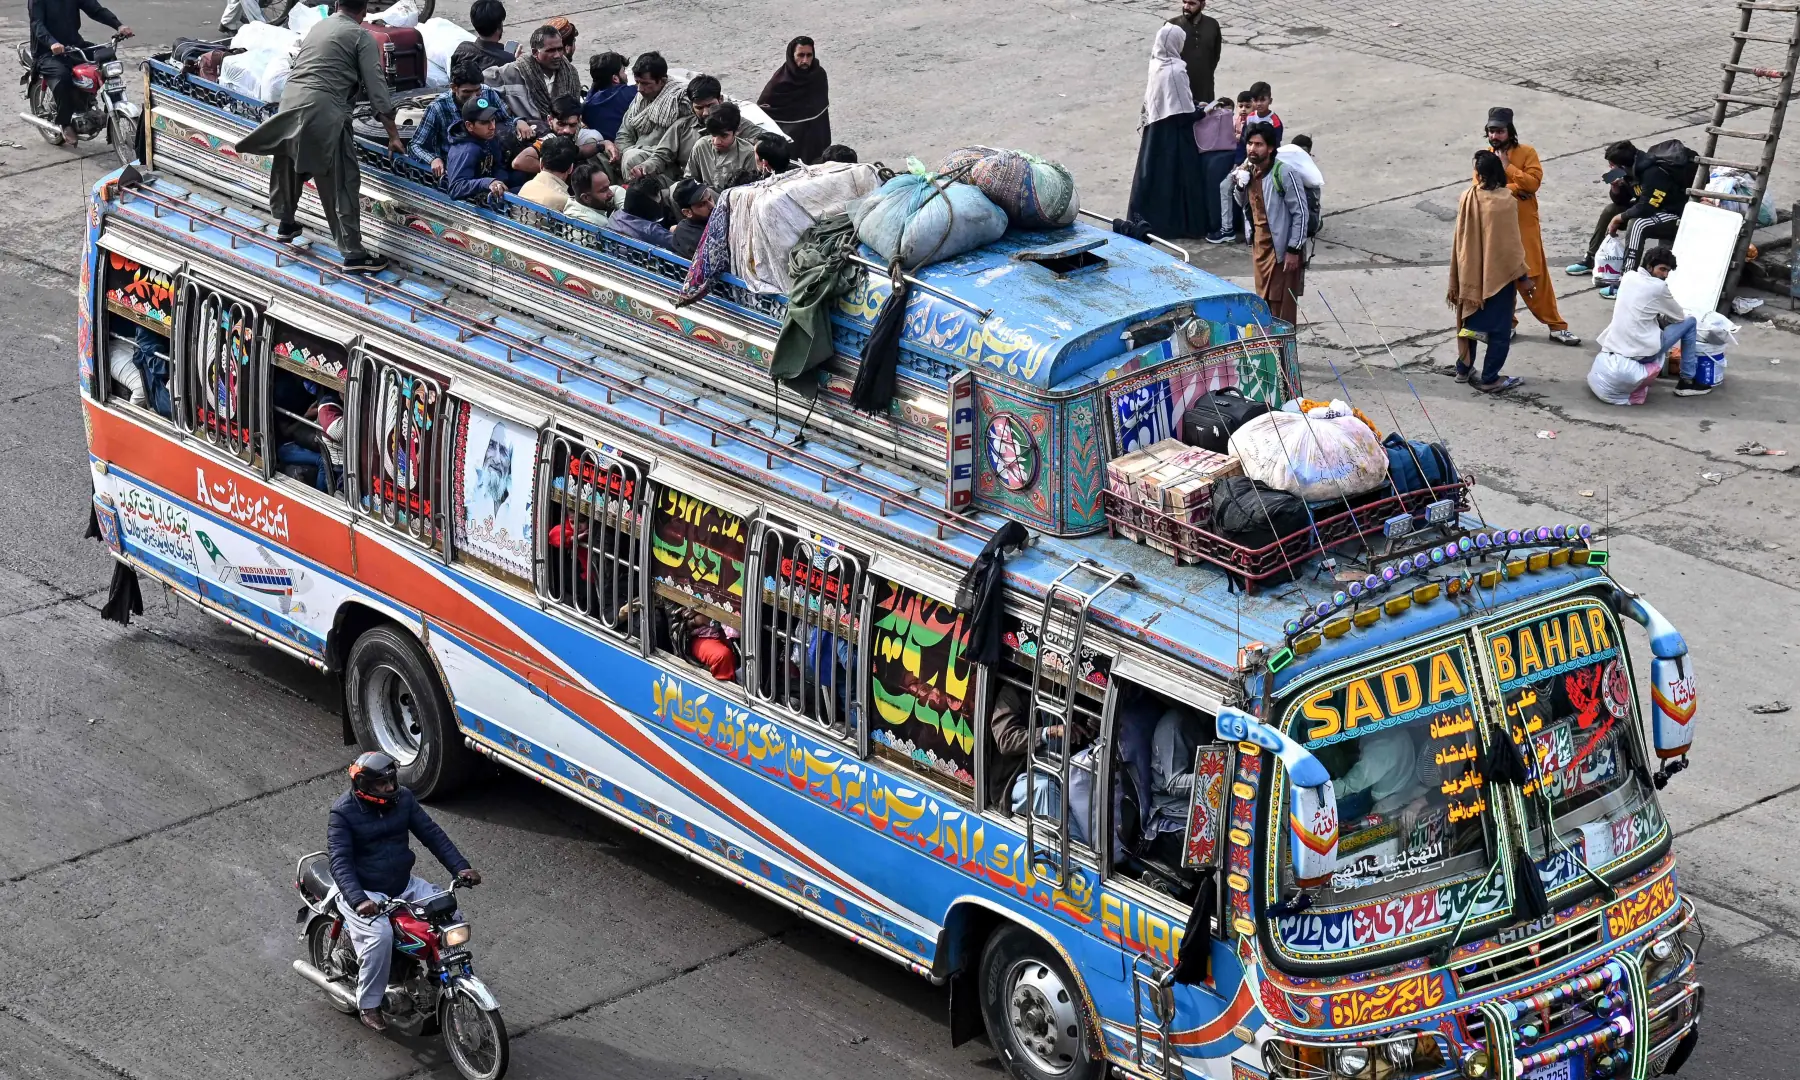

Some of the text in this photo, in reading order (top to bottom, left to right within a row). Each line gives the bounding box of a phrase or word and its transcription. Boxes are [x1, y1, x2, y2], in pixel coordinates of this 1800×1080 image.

[954, 381, 972, 506] SAEED
[196, 467, 210, 503] A
[239, 566, 287, 576] PAKISTAN AIR LINE
[1492, 608, 1610, 682] BAHAR
[1303, 652, 1465, 740] SADA
[1500, 913, 1555, 944] HINO
